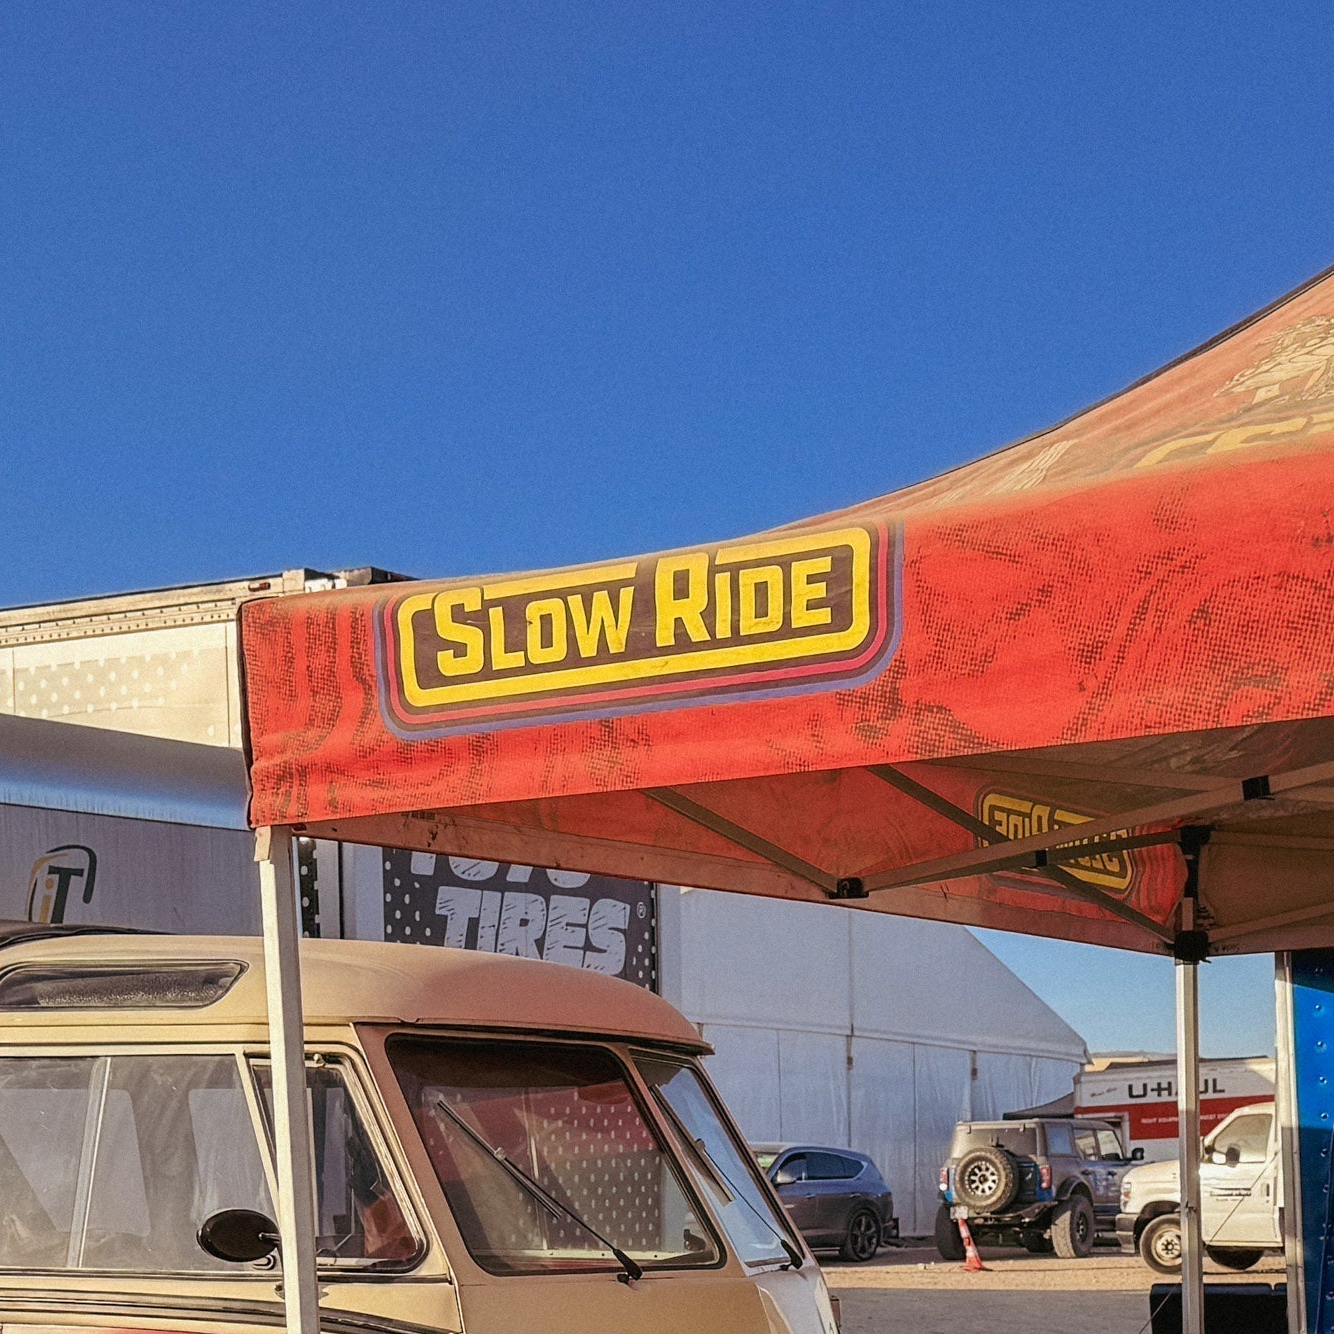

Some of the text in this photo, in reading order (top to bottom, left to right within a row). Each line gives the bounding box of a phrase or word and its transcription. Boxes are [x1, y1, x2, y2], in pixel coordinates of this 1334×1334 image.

[434, 550, 833, 676] SLOW RIDE
[435, 885, 630, 976] TIRES
[1128, 1078, 1225, 1099] U-HUL
